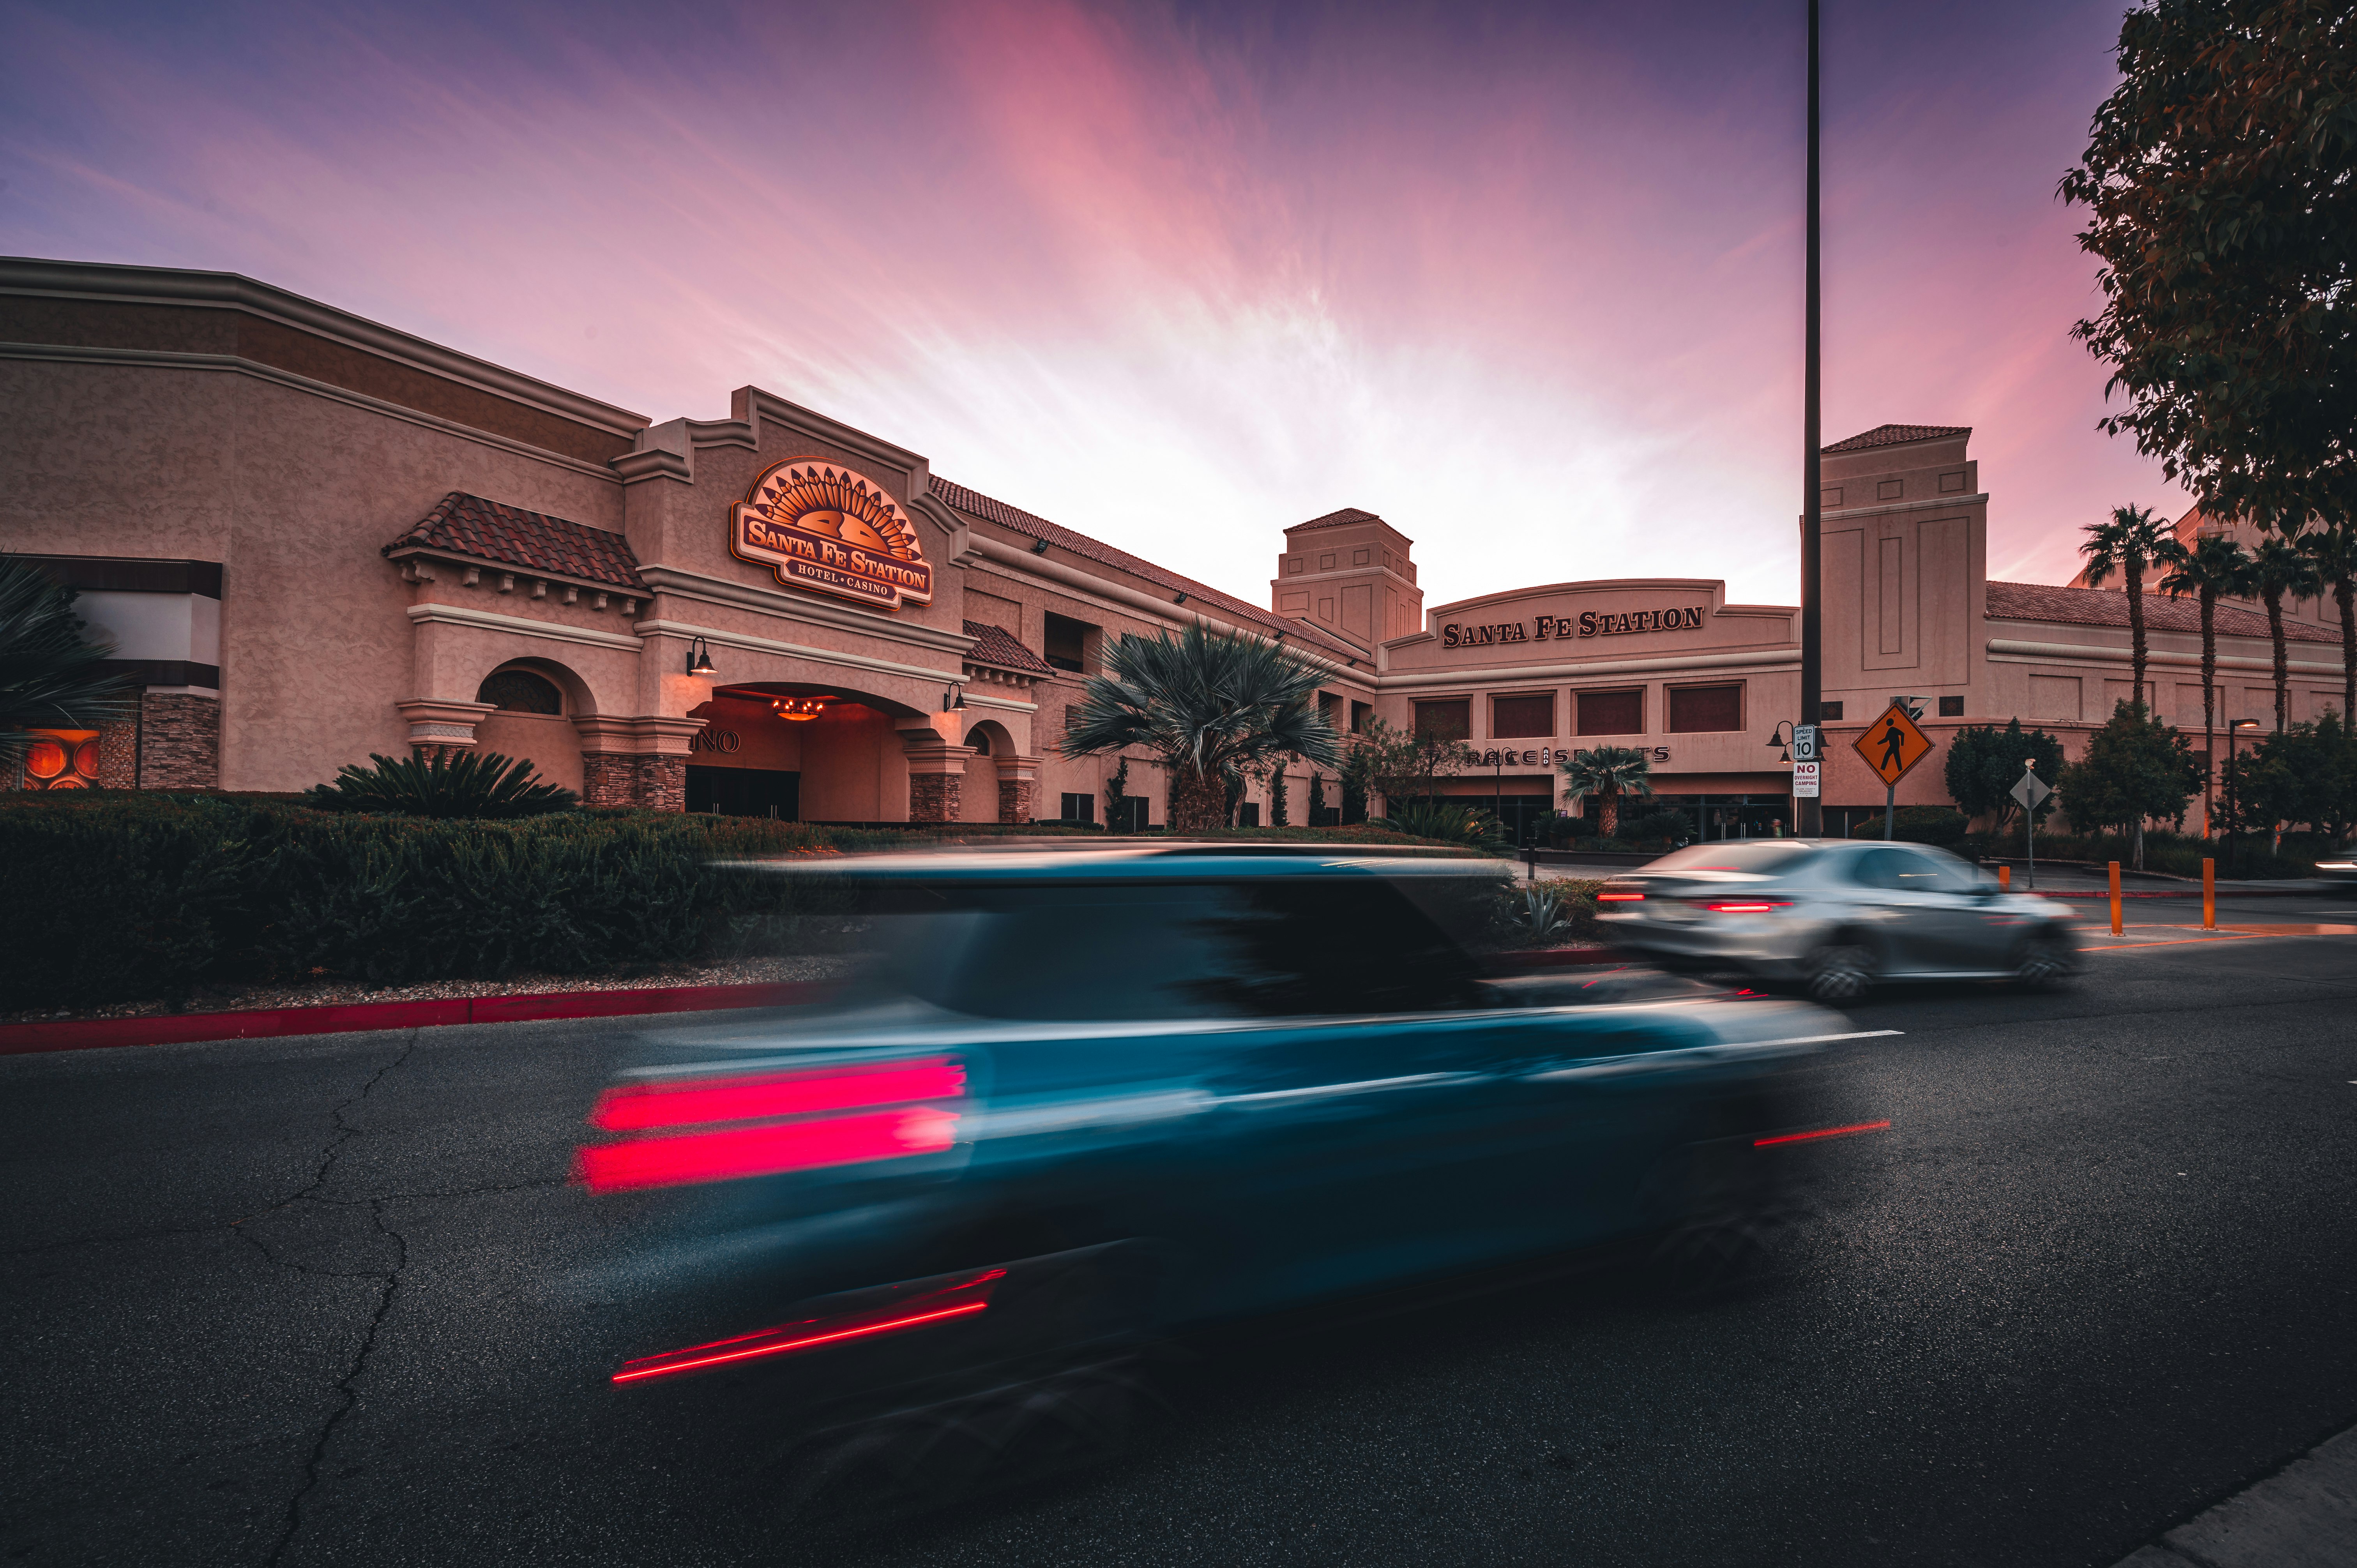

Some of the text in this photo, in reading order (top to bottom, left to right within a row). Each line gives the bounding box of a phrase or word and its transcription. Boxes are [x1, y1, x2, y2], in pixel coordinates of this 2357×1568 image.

[749, 521, 926, 589] SANTA FE STATION
[798, 564, 887, 595] HOTEL CASINO
[1443, 605, 1704, 648] SANTA FE STATION
[1796, 742, 1811, 756] 10
[1797, 765, 1815, 773] NO
